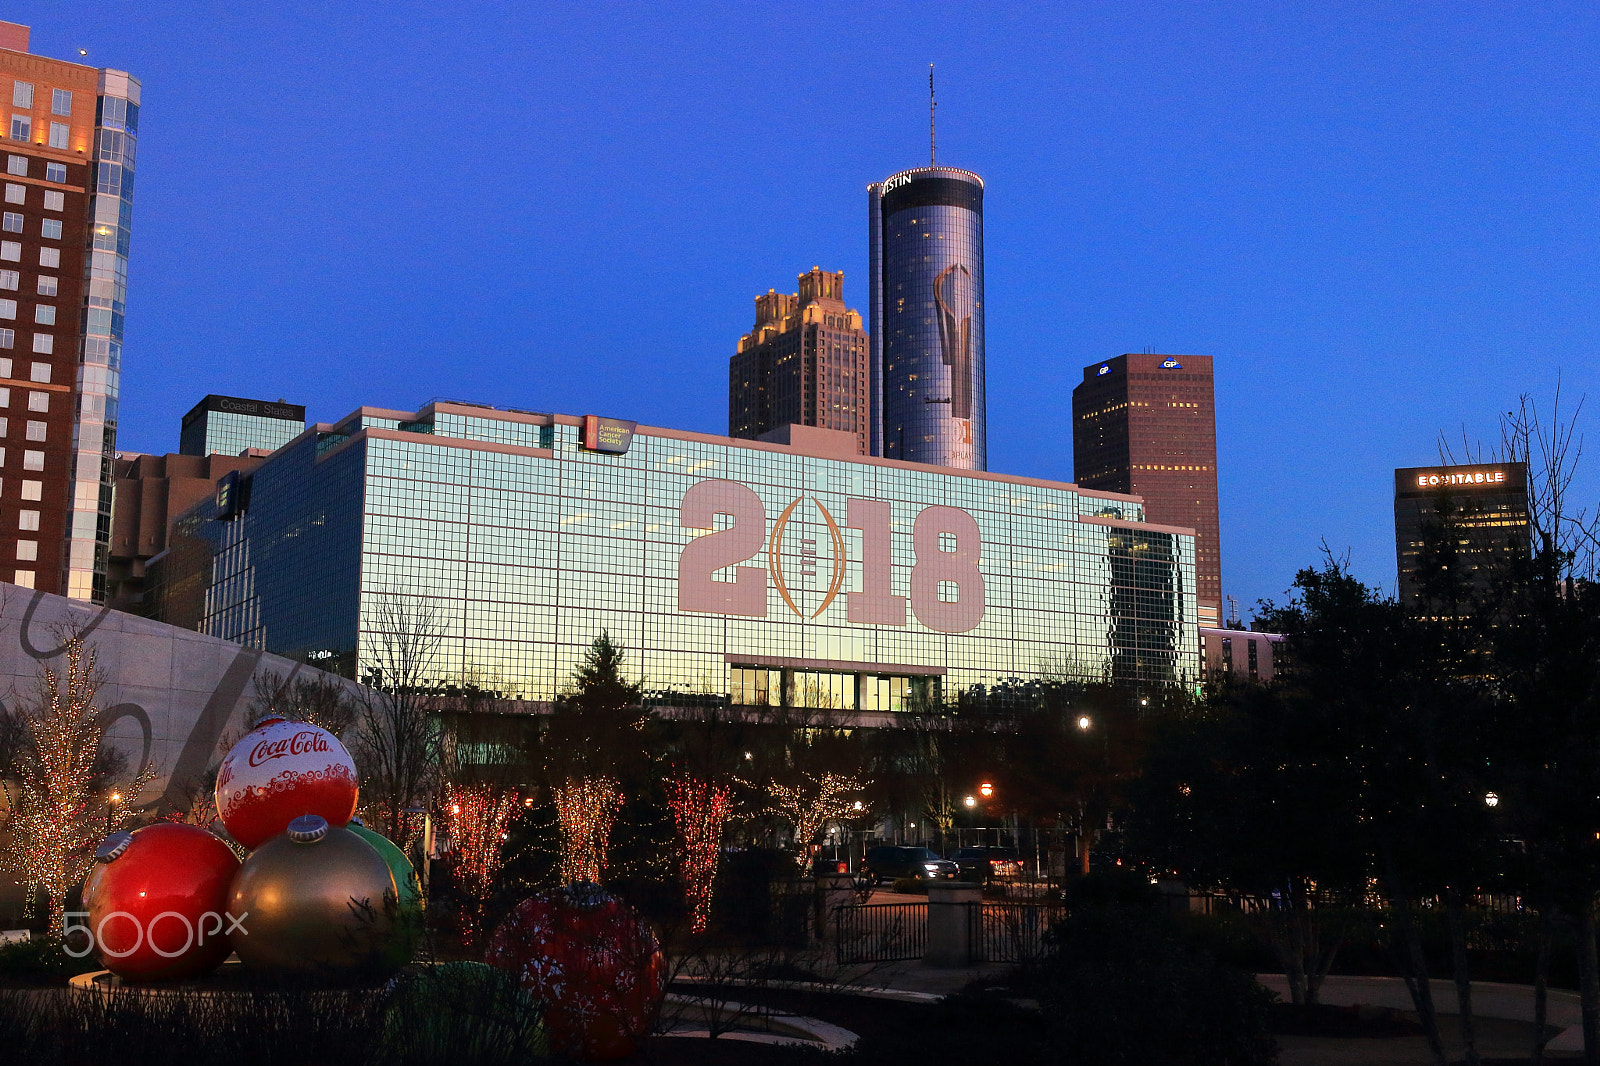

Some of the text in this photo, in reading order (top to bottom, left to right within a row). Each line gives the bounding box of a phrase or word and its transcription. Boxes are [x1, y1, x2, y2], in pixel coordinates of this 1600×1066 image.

[220, 399, 294, 417] Coastal States
[599, 424, 630, 434] American
[599, 430, 621, 439] Cancer
[599, 436, 622, 445] Society
